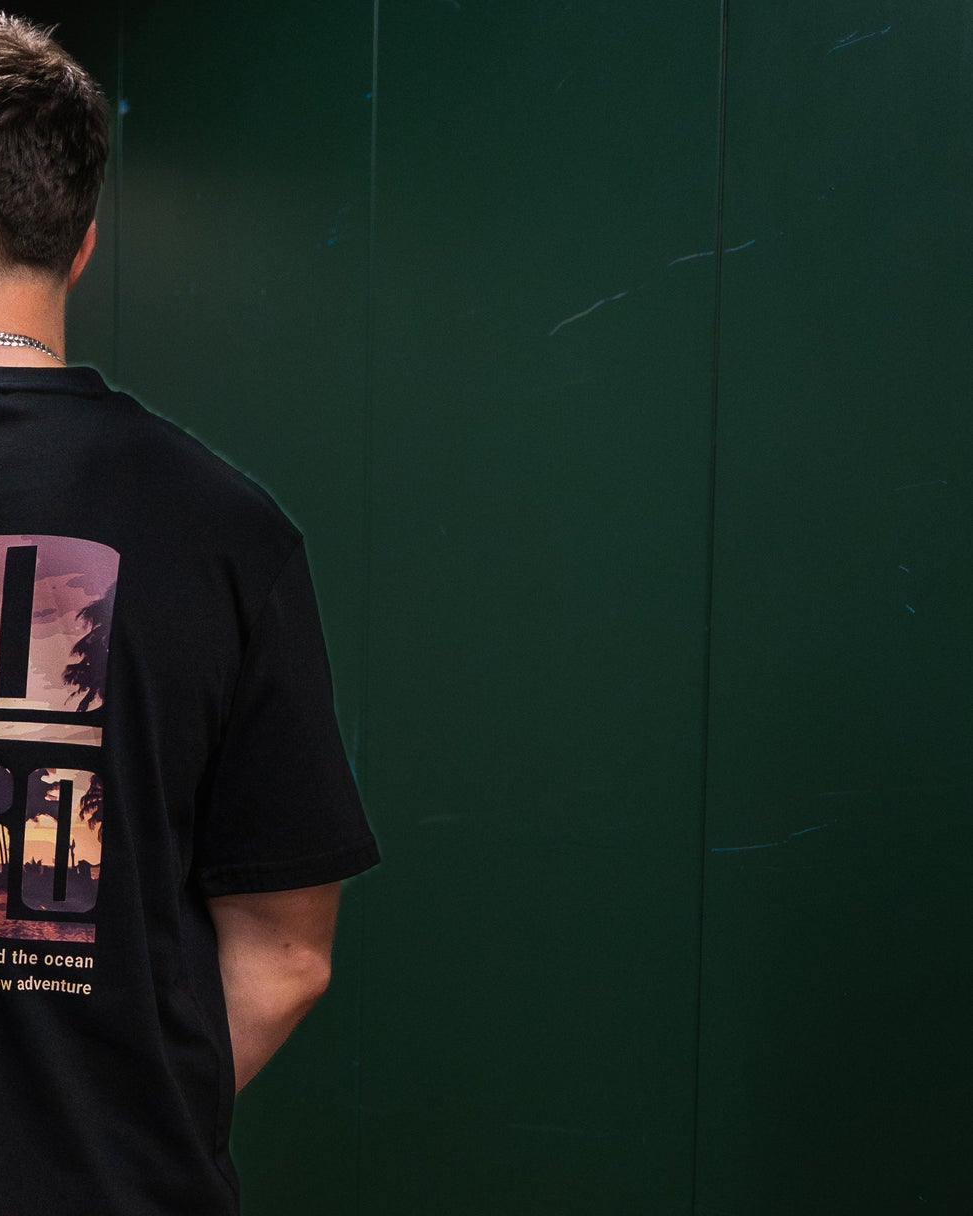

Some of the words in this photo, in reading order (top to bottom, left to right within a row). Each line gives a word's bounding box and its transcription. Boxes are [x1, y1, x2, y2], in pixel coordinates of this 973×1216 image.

[11, 949, 38, 965] the
[44, 953, 94, 969] ocean
[17, 976, 92, 995] adventure
